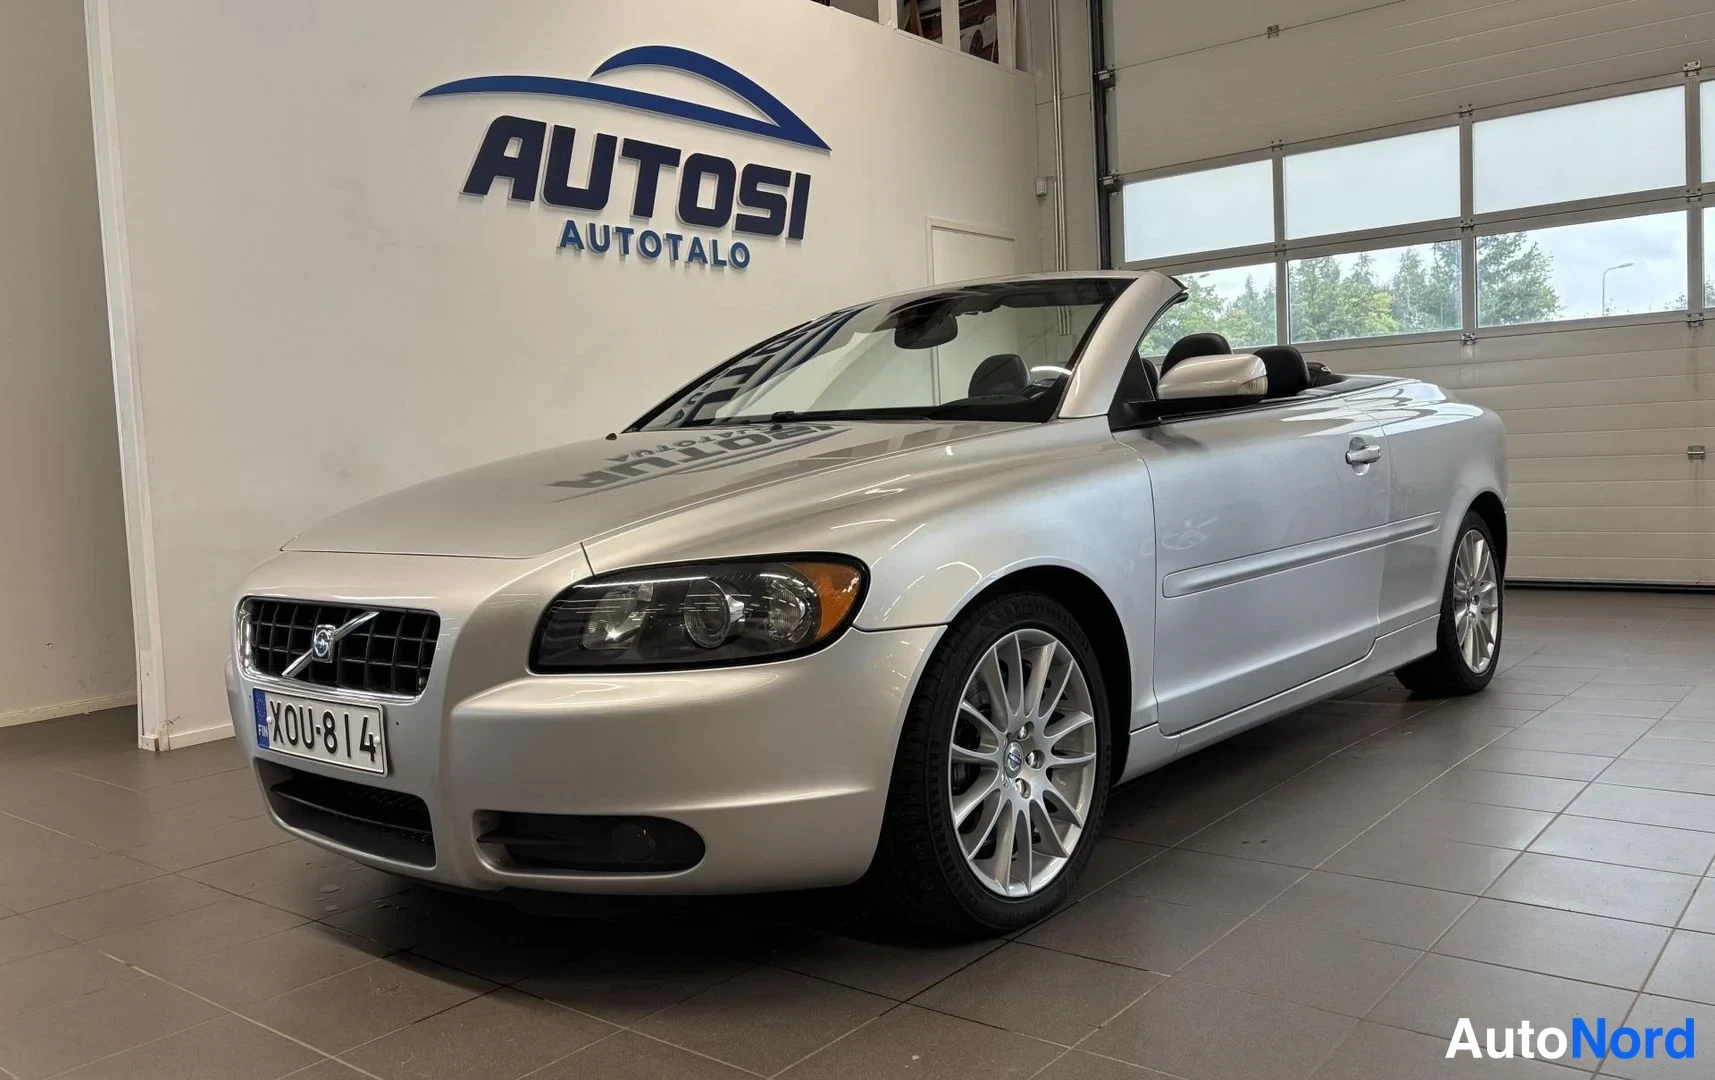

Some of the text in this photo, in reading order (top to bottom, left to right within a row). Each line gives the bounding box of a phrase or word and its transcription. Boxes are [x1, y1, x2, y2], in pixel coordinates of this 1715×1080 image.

[461, 115, 811, 240] AUTOSI
[559, 220, 750, 268] AUTOTALO
[270, 700, 376, 762] XOU-814
